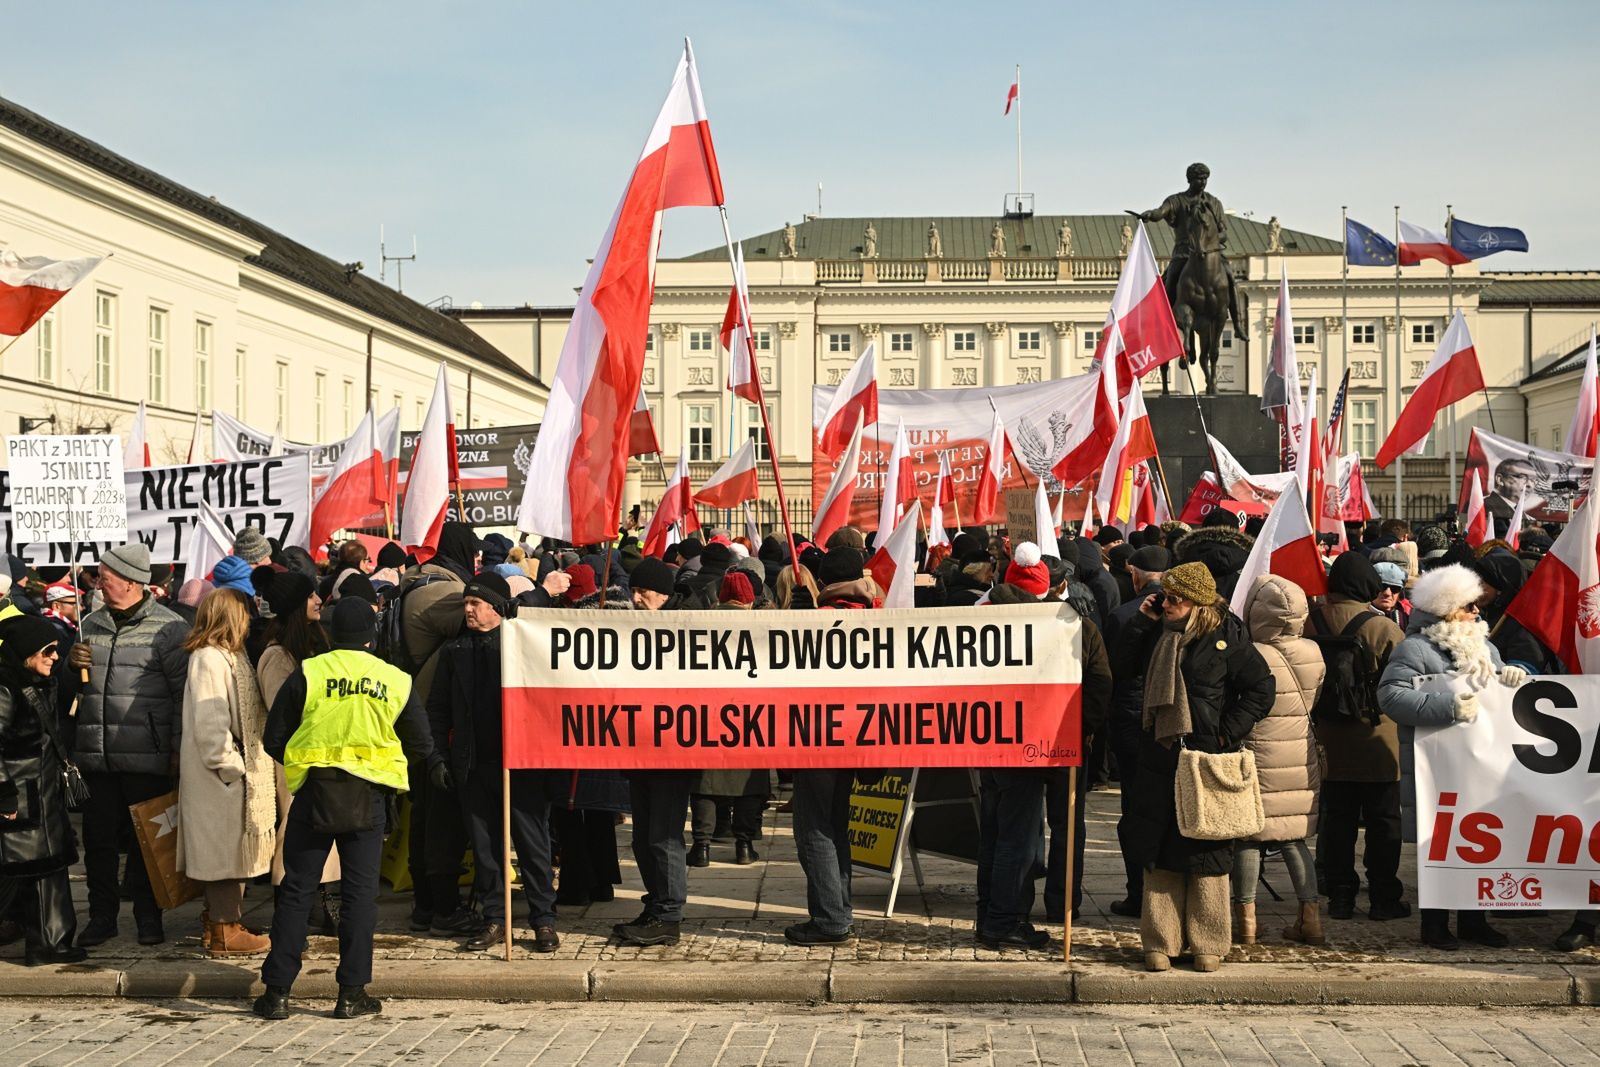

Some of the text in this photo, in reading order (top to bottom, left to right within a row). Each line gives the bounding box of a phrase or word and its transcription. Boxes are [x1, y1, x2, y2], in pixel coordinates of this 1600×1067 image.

[10, 439, 48, 457] PAKT
[63, 439, 114, 457] JAŁTY
[13, 486, 88, 505] ZAWARTY
[140, 460, 283, 510] NIEMIEC
[551, 620, 1033, 679] POD OPIEKĄ DWÓCH KAROLI
[326, 677, 388, 703] POLICJA
[561, 701, 1023, 748] NIKT POLSKI NIE ZNIEWOLI
[863, 808, 899, 830] CHCESZ
[1428, 792, 1504, 864] is
